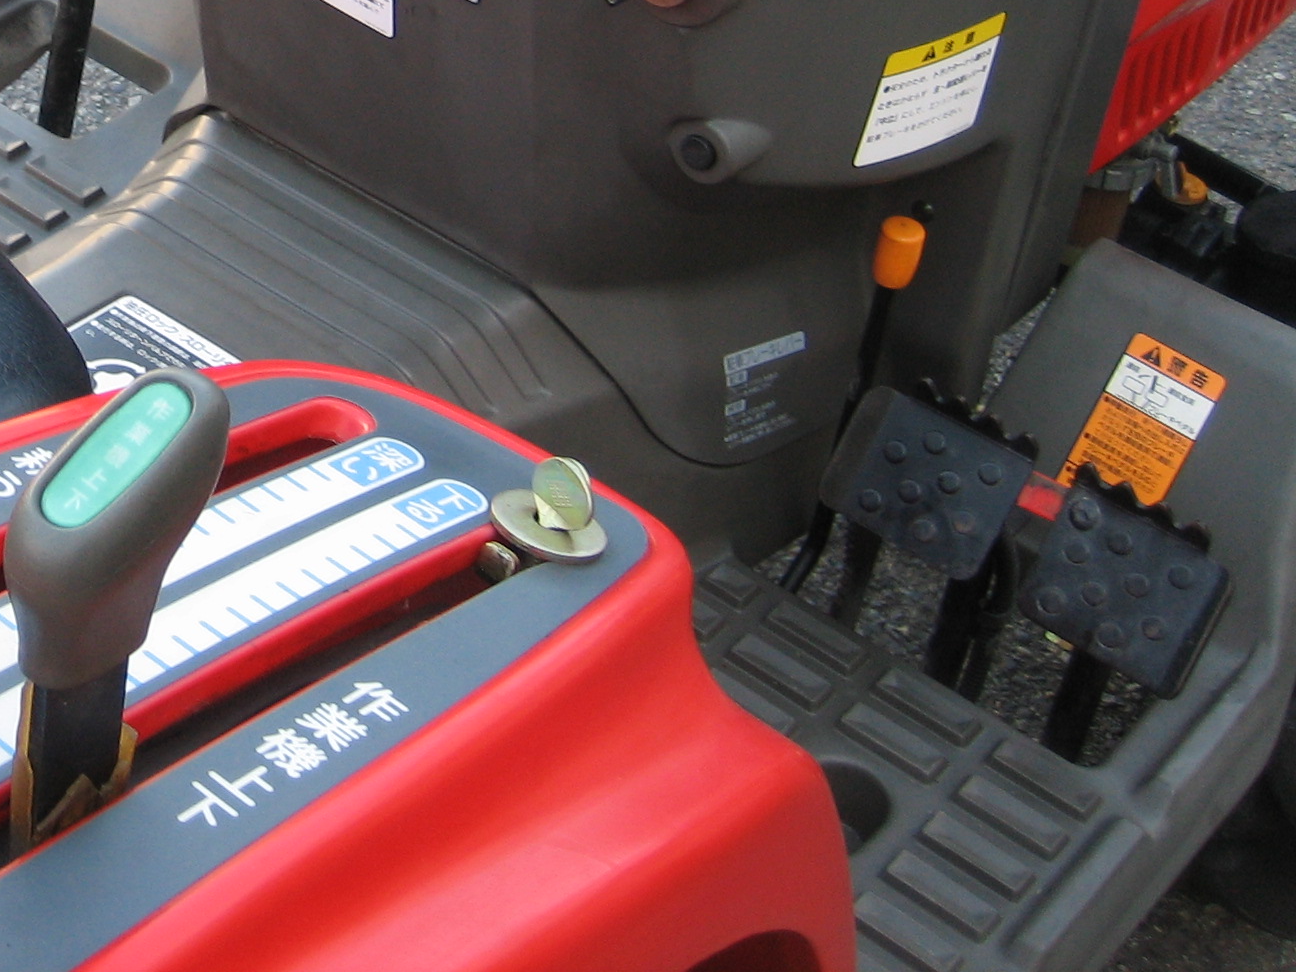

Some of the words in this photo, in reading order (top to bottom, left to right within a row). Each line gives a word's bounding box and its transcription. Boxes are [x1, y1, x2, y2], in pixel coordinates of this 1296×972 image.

[341, 442, 415, 482] 深い
[406, 484, 479, 524] 下る
[176, 680, 410, 827] 作業機上下
